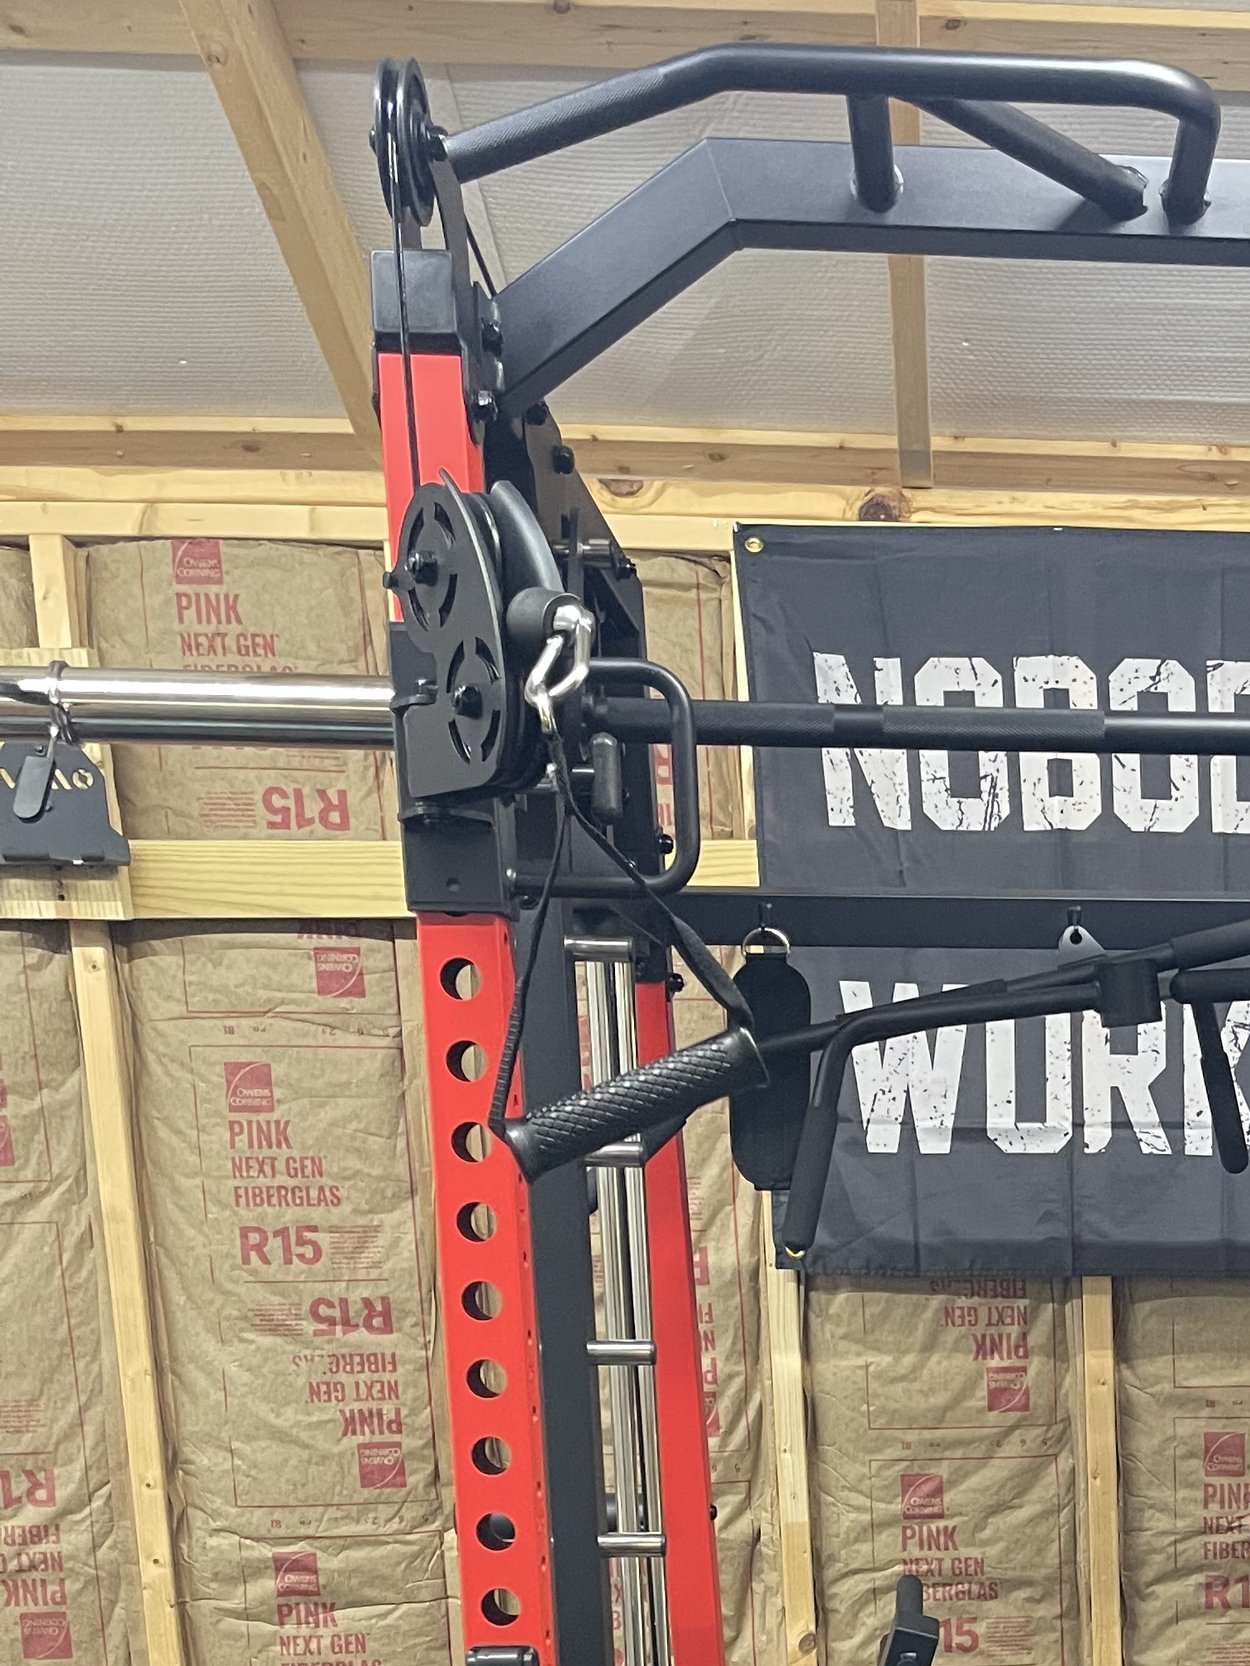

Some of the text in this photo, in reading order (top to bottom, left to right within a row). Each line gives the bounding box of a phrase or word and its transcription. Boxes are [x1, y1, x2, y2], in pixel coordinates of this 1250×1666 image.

[175, 592, 243, 625] PINK
[180, 633, 277, 657] NEXT GEN
[262, 786, 350, 831] R15
[228, 1119, 292, 1150] PINK
[231, 1156, 324, 1179] NEXT GEN
[234, 1185, 342, 1208] FIBERGLAS
[239, 1224, 323, 1265] R15
[309, 1296, 393, 1337] R15
[943, 1306, 1028, 1327] NEXT GEN
[972, 1333, 1028, 1361] PINK
[308, 1381, 399, 1403] NEXT GEN
[341, 1408, 402, 1437] PINK
[0, 1468, 57, 1508] R1
[1202, 1515, 1243, 1534] NEXT
[901, 1525, 958, 1552] PINK
[14, 1552, 63, 1572] NEXT
[902, 1557, 985, 1577] NEXT GEN
[0, 1578, 67, 1606] PINK
[922, 1582, 999, 1602] BERGLAS
[277, 1602, 337, 1628] PINK
[279, 1633, 366, 1655] NEXT GEN
[940, 1617, 980, 1654] 15
